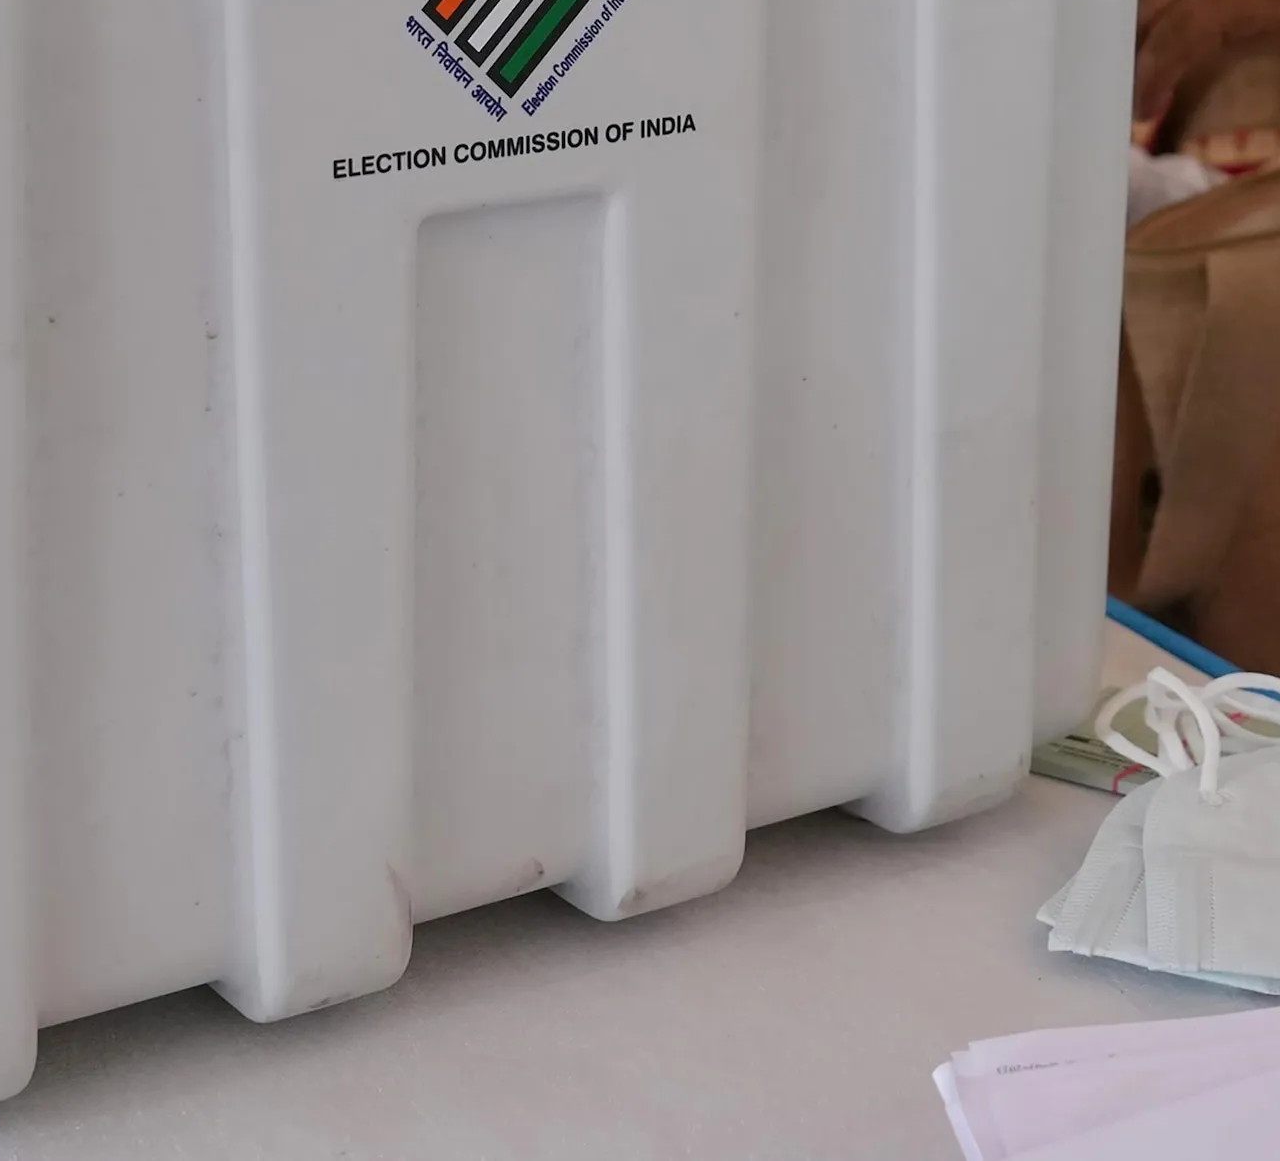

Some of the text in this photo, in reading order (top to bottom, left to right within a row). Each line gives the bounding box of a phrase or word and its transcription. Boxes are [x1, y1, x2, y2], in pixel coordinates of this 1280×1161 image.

[405, 15, 436, 50] भारत
[471, 84, 508, 123] आयोग
[520, 73, 560, 117] Election
[552, 24, 601, 79] Commission
[601, 4, 614, 22] of
[332, 113, 697, 180] ELECTION COMMISSION OF INDIA
